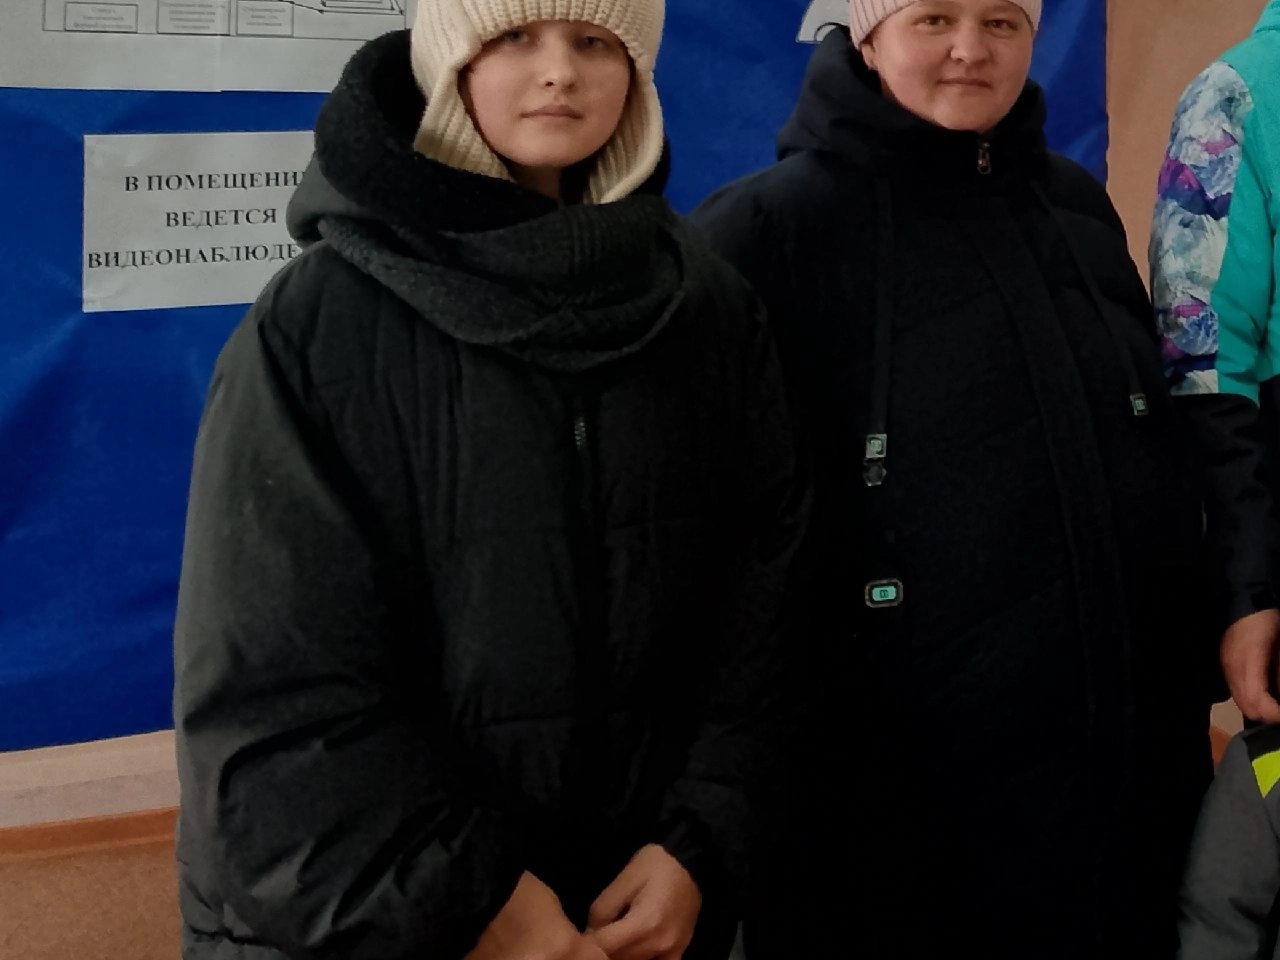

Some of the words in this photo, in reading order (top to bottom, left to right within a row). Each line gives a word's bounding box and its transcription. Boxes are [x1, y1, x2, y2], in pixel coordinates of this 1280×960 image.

[125, 176, 139, 191] В
[147, 172, 305, 191] ПОМЕЩЕНИ
[165, 208, 277, 229] ВЕДЕТСЯ
[88, 243, 300, 269] ВИДЕОНАБЛЮДЕ
